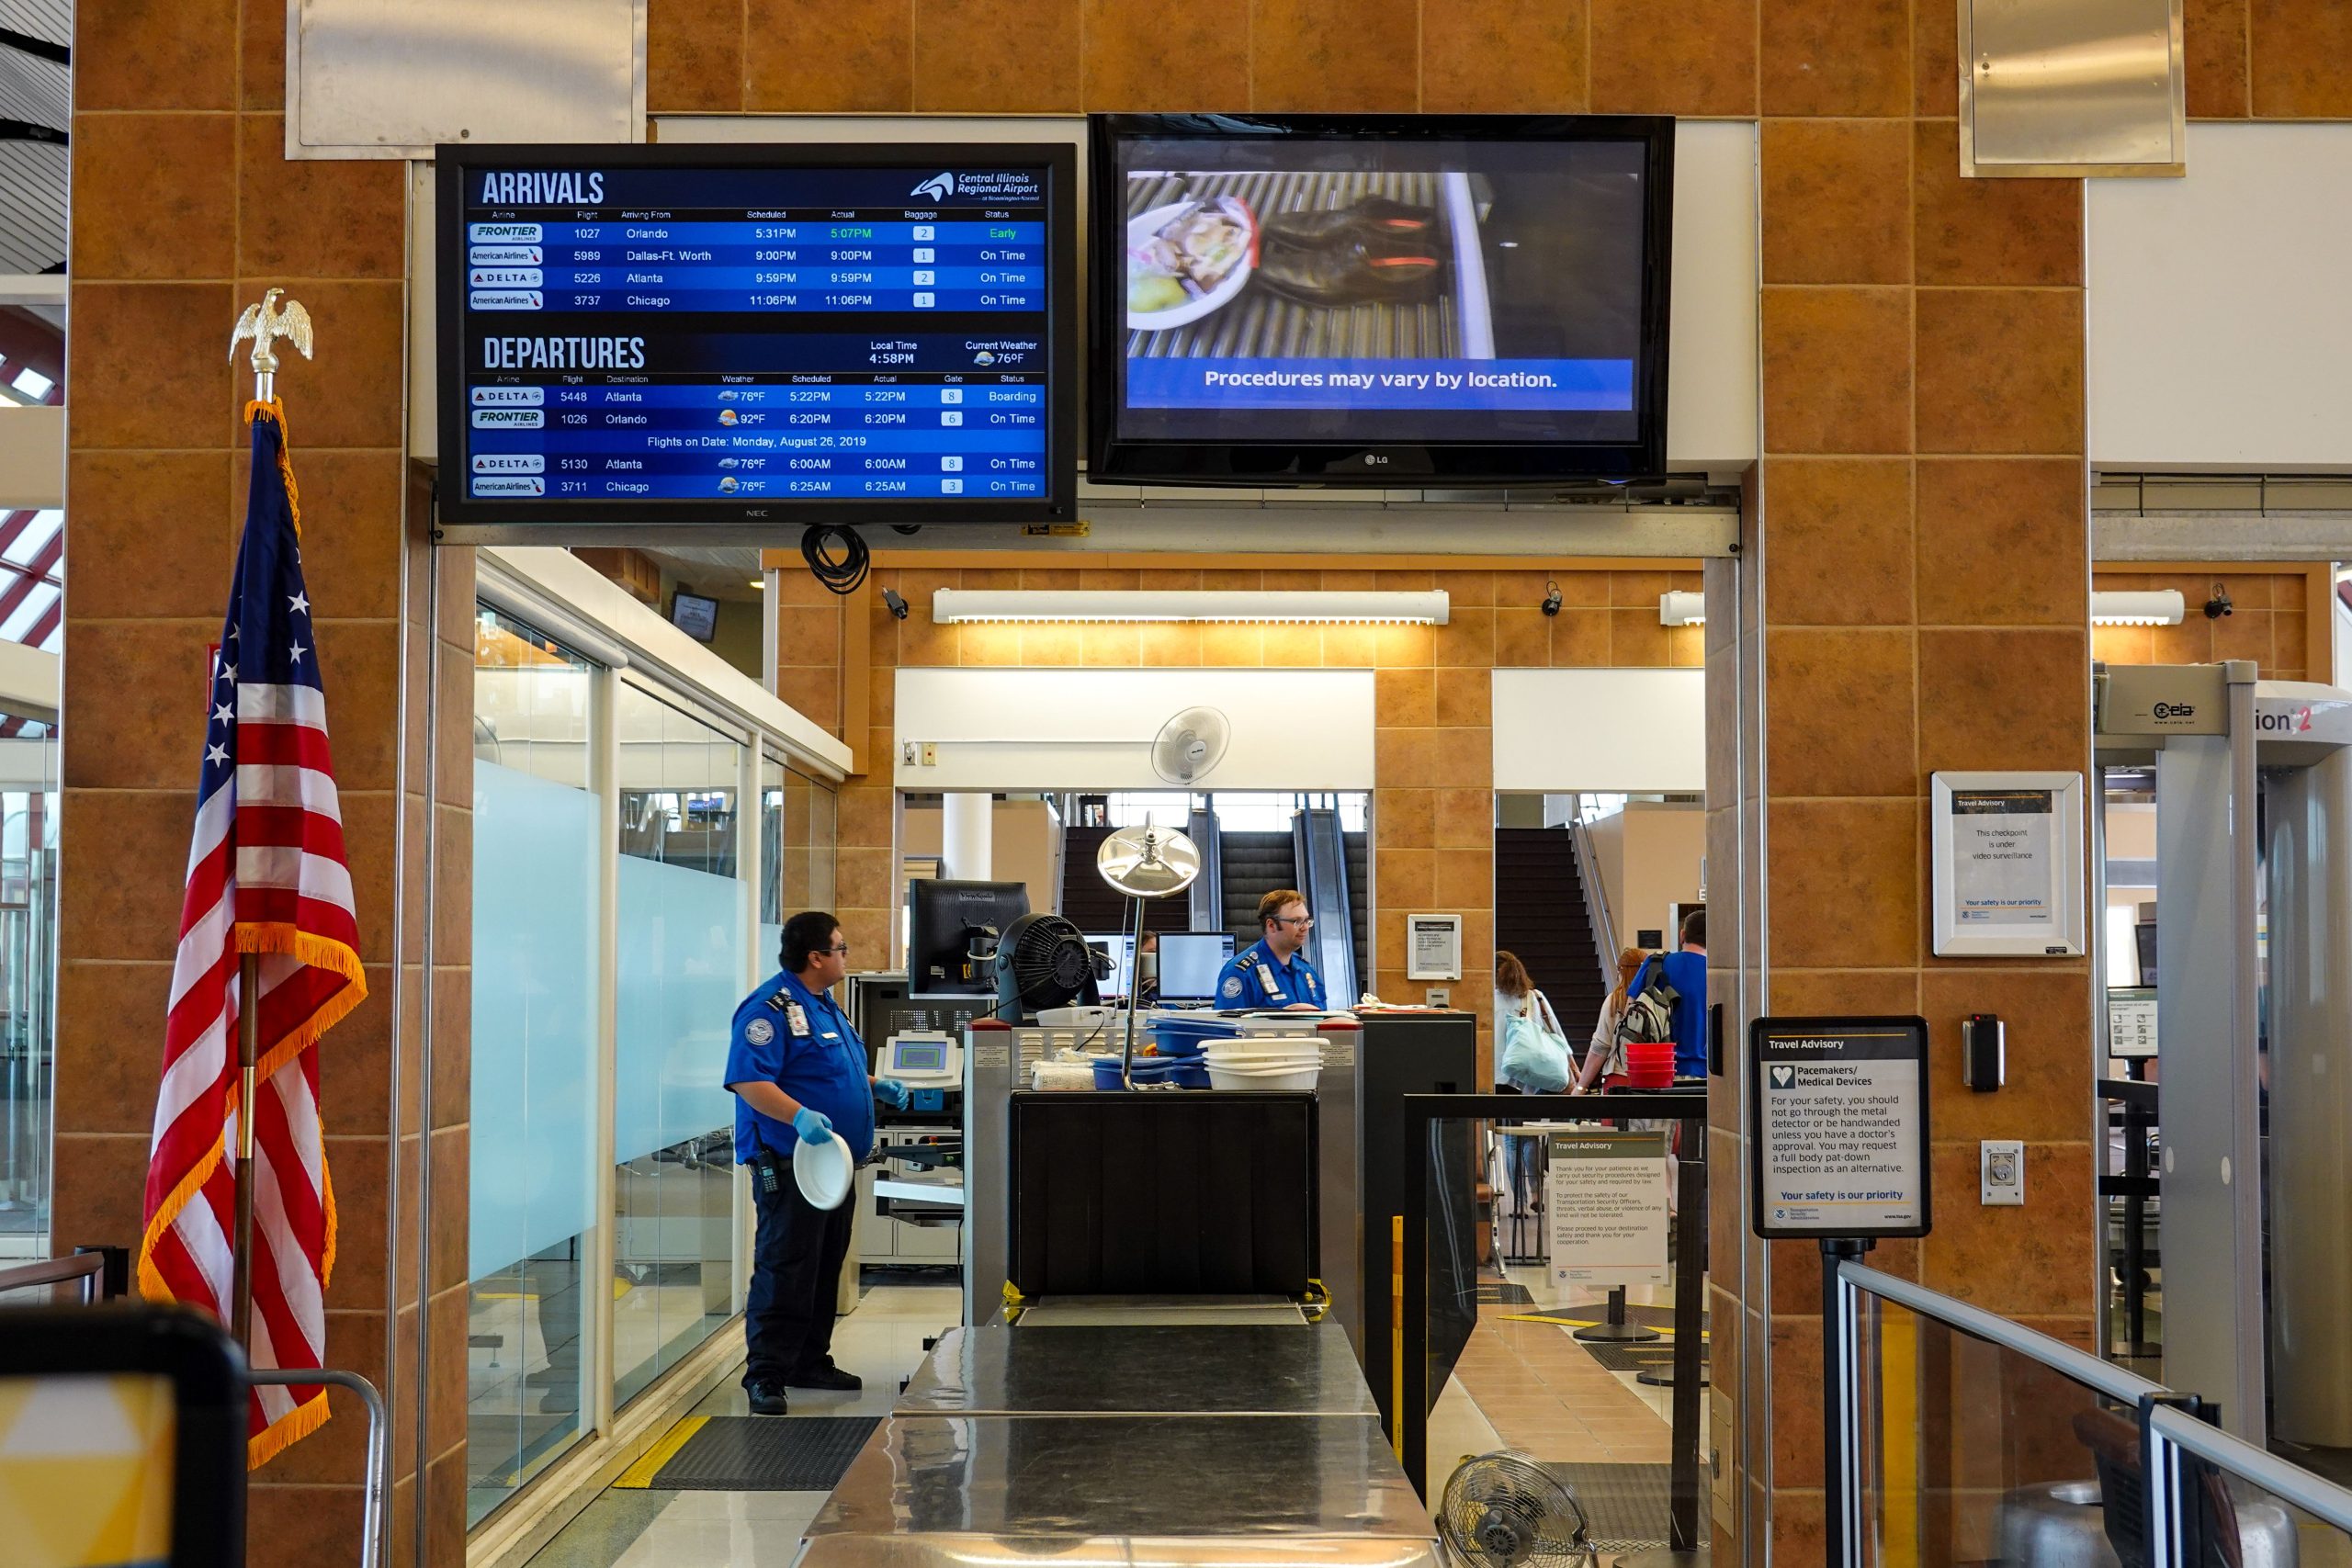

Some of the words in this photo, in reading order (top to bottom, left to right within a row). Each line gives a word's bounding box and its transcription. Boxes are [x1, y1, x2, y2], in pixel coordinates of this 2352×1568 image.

[959, 174, 994, 183] Central
[996, 173, 1029, 183] Illinois
[482, 173, 604, 204] ARRIVALS
[957, 184, 1001, 195] Regional
[1003, 183, 1038, 195] Airport
[577, 211, 598, 220] Flight
[621, 211, 649, 220] Arriving
[747, 210, 786, 219] Scheduled
[831, 210, 854, 219] Actual
[904, 210, 937, 220] Baggage
[478, 227, 537, 235] FRONTIER
[575, 229, 600, 238] 1027
[627, 229, 668, 238] Orlando
[756, 229, 796, 238] 5:31PM
[831, 228, 872, 238] 5:07PM
[990, 228, 1016, 240] Early
[574, 251, 600, 261] 5989
[627, 251, 675, 261] Dallas-Ft.
[679, 251, 711, 261] Worth
[756, 251, 796, 260] 9:00PM
[831, 251, 872, 260] 9:00PM
[980, 251, 996, 260] On
[1000, 251, 1025, 260] Time
[487, 274, 526, 282] DELTA
[574, 273, 601, 283] 5226
[627, 274, 663, 283] Atlanta
[756, 273, 797, 283] 9:59PM
[831, 273, 872, 283] 9:59PM
[980, 273, 996, 282] On
[1000, 273, 1025, 282] Time
[574, 296, 601, 305] 3737
[627, 296, 671, 308] Chicago
[750, 296, 797, 305] 11:06PM
[825, 295, 872, 305] 11:06PM
[980, 295, 996, 305] On
[1000, 295, 1025, 305] Time
[871, 341, 893, 350] Local
[895, 341, 917, 350] Time
[966, 341, 998, 350] Current
[1000, 341, 1037, 349] Weather
[485, 337, 644, 368] DEPARTURES
[869, 354, 913, 364] 4:58PM
[606, 375, 649, 383] Destination
[722, 375, 754, 383] Weather
[1205, 371, 1323, 387] Procedures
[1329, 374, 1374, 389] may
[1380, 375, 1430, 389] vary
[1436, 371, 1463, 389] by
[1469, 372, 1557, 388] location.
[489, 392, 528, 400] DELTA
[560, 392, 587, 401] 5448
[605, 392, 642, 401] Atlanta
[790, 391, 831, 401] 5:22PM
[865, 391, 905, 401] 5:22PM
[989, 391, 1036, 403] Boarding
[480, 412, 538, 422] FRONTIER
[561, 414, 587, 423] 1026
[605, 414, 647, 423] Orlando
[790, 414, 831, 423] 6:20PM
[865, 414, 905, 423] 6:20PM
[990, 413, 1006, 423] On
[1009, 413, 1035, 423] Time
[648, 437, 682, 448] Flights
[702, 437, 729, 446] Date:
[733, 436, 776, 448] Monday,
[780, 436, 817, 448] August
[820, 436, 836, 447] 26,
[840, 436, 866, 446] 2019
[561, 459, 588, 469] 5130
[605, 459, 642, 469] Atlanta
[790, 459, 831, 468] 6:00AM
[865, 459, 906, 468] 6:00AM
[990, 458, 1006, 468] On
[1009, 458, 1035, 468] Time
[561, 481, 586, 491] 3711
[606, 481, 649, 493] Chicago
[790, 481, 831, 491] 6:25AM
[865, 481, 906, 491] 6:25AM
[990, 481, 1006, 491] On
[1010, 481, 1035, 491] Time
[1769, 1040, 1799, 1049] Travel
[1801, 1040, 1844, 1049] Advisory
[1797, 1066, 1858, 1075] Pacemakers/
[1798, 1077, 1834, 1086] Medical
[1837, 1077, 1871, 1086] Devices
[1771, 1097, 1787, 1105] For
[1790, 1098, 1811, 1107] your
[1814, 1096, 1845, 1106] safety,
[1848, 1097, 1865, 1106] you
[1868, 1095, 1899, 1104] should
[1771, 1109, 1787, 1117] not
[1790, 1109, 1801, 1118] go
[1804, 1108, 1840, 1117] through
[1843, 1107, 1859, 1116] the
[1861, 1107, 1887, 1116] metal
[1771, 1119, 1811, 1128] detector
[1826, 1119, 1838, 1127] be
[1840, 1118, 1900, 1127] handwanded
[1772, 1131, 1802, 1140] unless
[1804, 1132, 1822, 1141] you
[1825, 1131, 1848, 1139] have
[1858, 1130, 1895, 1138] doctor's
[1772, 1142, 1815, 1152] approval.
[1818, 1142, 1836, 1150] You
[1839, 1143, 1860, 1151] may
[1862, 1142, 1896, 1151] request
[1781, 1153, 1796, 1162] full
[1799, 1153, 1823, 1163] body
[1826, 1152, 1870, 1163] pat-down
[1773, 1165, 1821, 1175] inspection
[1850, 1164, 1904, 1173] alternative.
[1781, 1191, 1803, 1200] Your
[1805, 1190, 1835, 1201] safety
[1838, 1191, 1846, 1200] is
[1866, 1190, 1903, 1201] priority
